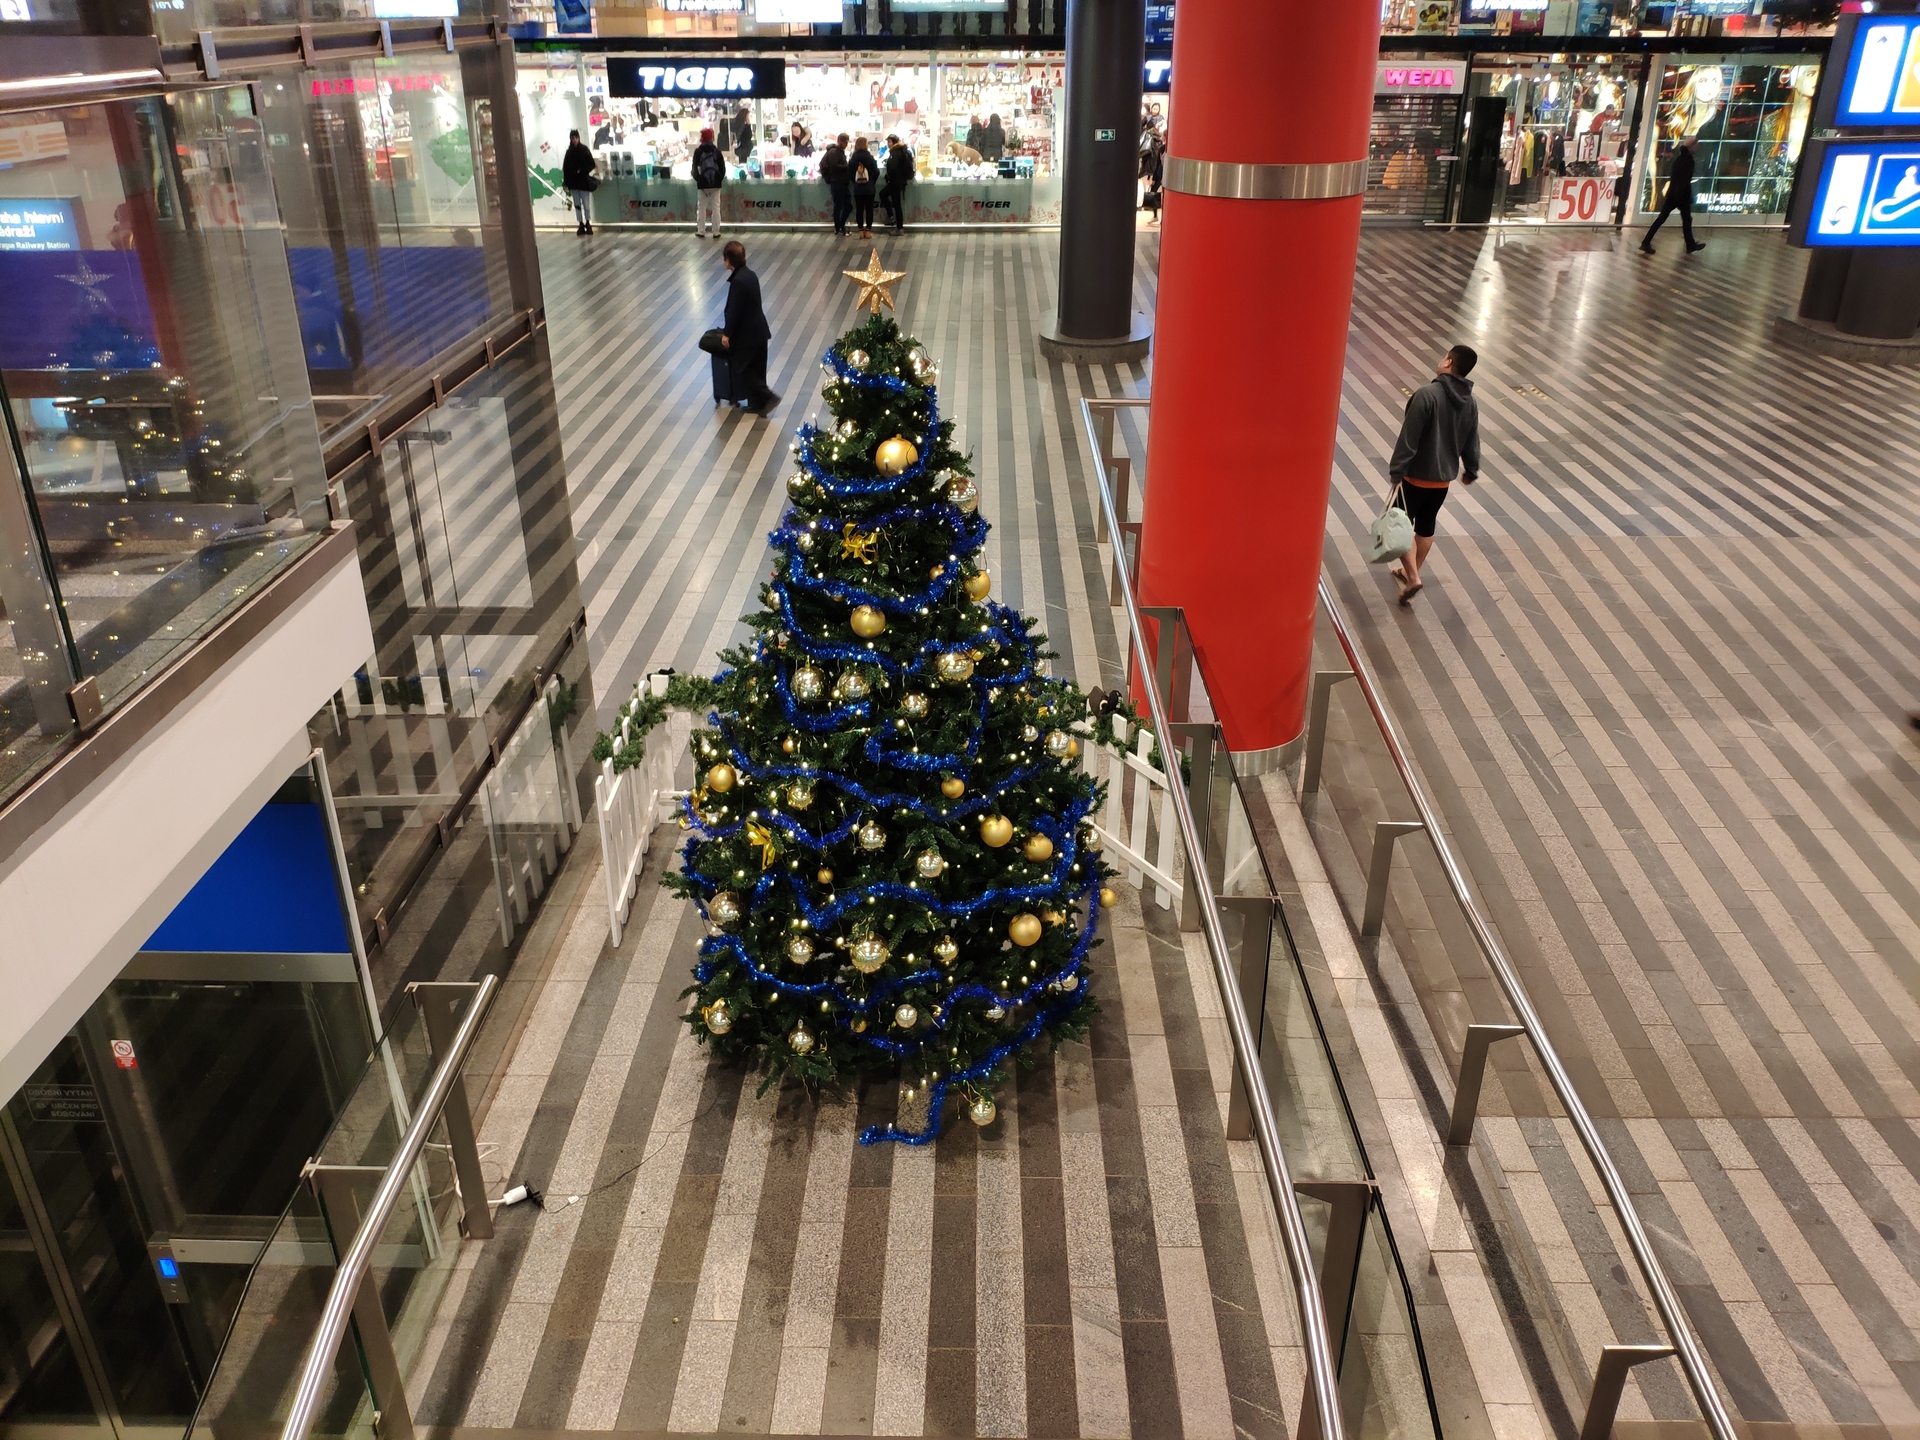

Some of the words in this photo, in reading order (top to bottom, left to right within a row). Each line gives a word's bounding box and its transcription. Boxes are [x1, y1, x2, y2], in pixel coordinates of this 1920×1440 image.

[638, 67, 754, 90] TIGER
[1558, 179, 1613, 220] 50%
[629, 200, 667, 208] TIGER
[743, 200, 782, 208] TIGER
[15, 242, 45, 250] Railway
